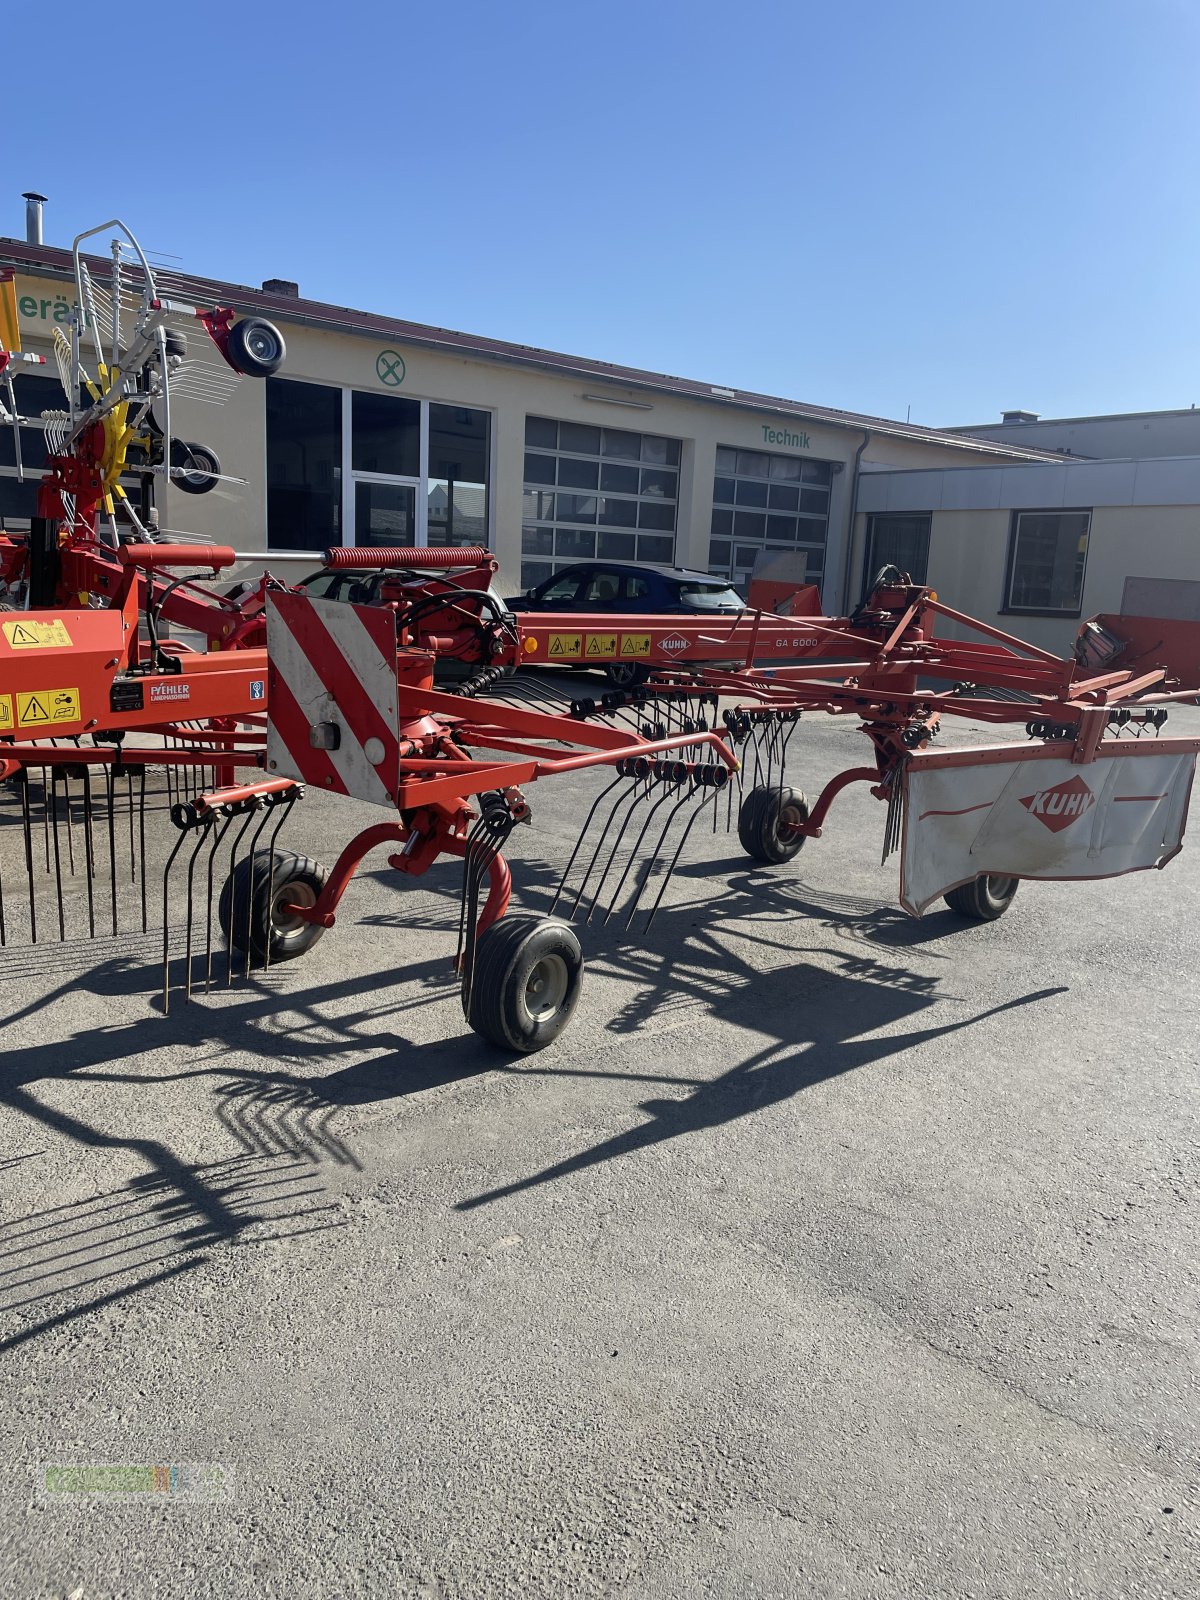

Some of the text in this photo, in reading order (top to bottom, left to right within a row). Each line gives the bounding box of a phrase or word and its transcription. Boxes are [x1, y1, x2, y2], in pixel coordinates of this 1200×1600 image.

[762, 425, 811, 449] Technik
[662, 639, 688, 650] KUHN
[775, 638, 818, 648] GA 6000
[1027, 791, 1094, 816] KUHN
